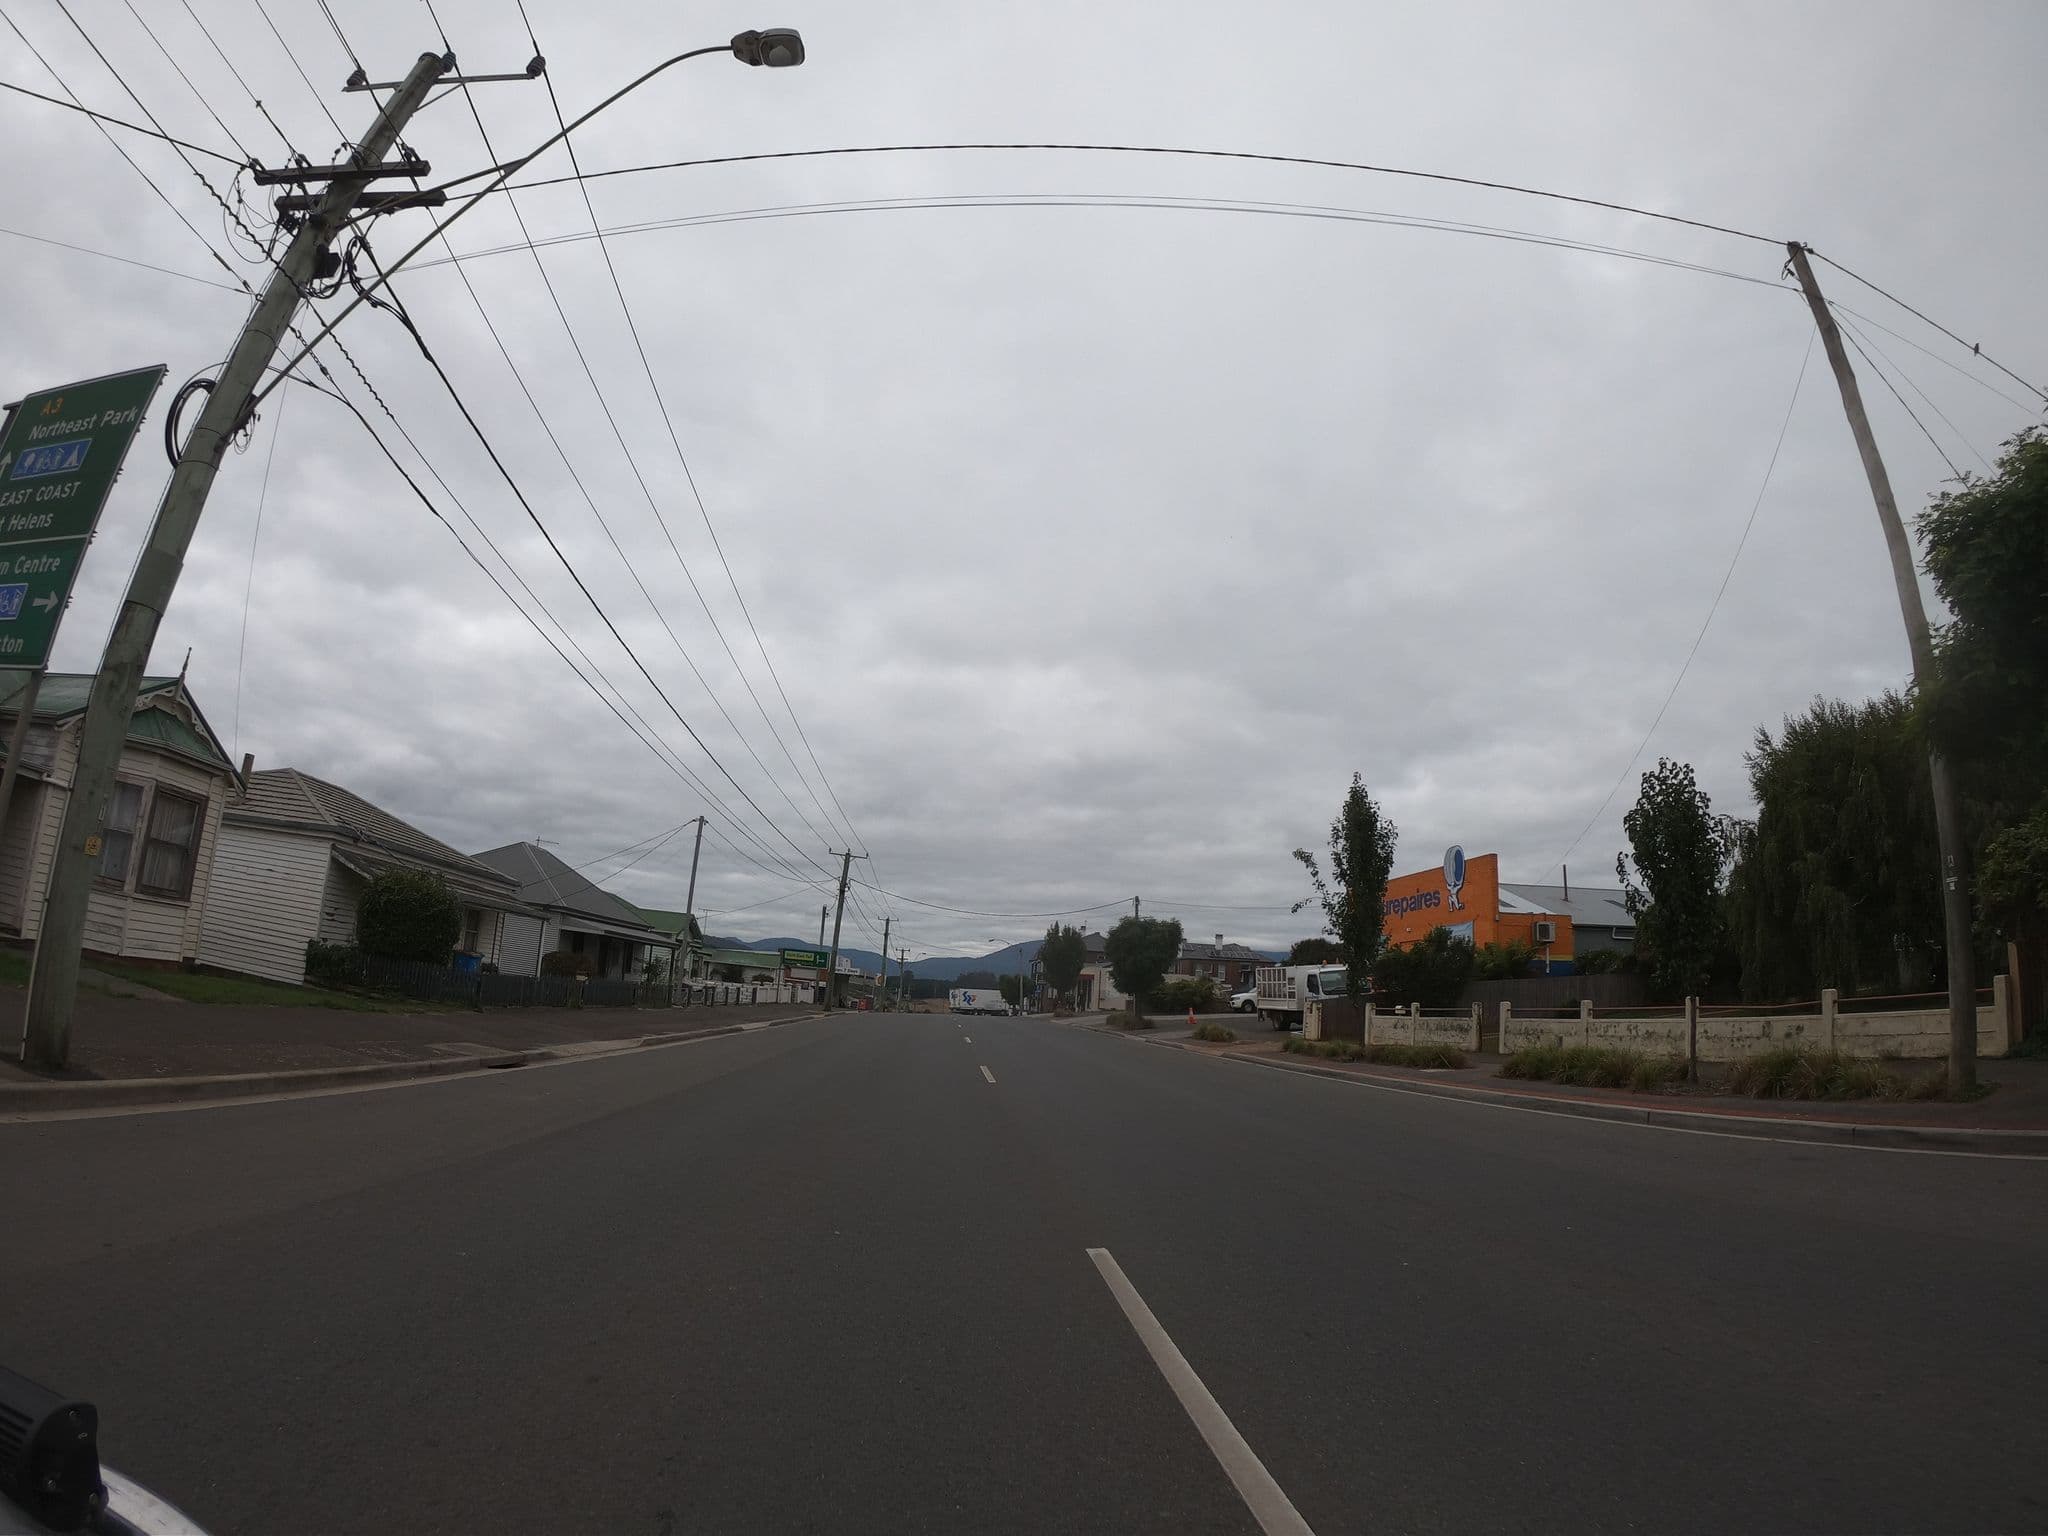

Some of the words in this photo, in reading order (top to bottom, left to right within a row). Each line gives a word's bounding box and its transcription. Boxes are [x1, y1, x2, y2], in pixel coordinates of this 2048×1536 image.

[40, 395, 65, 416] A3
[28, 413, 97, 441] Northeast
[98, 405, 138, 428] Park
[0, 488, 33, 507] EAST
[36, 481, 81, 502] COAST
[8, 512, 54, 532] Helens
[14, 554, 61, 575] Centre
[0, 634, 24, 654] ton
